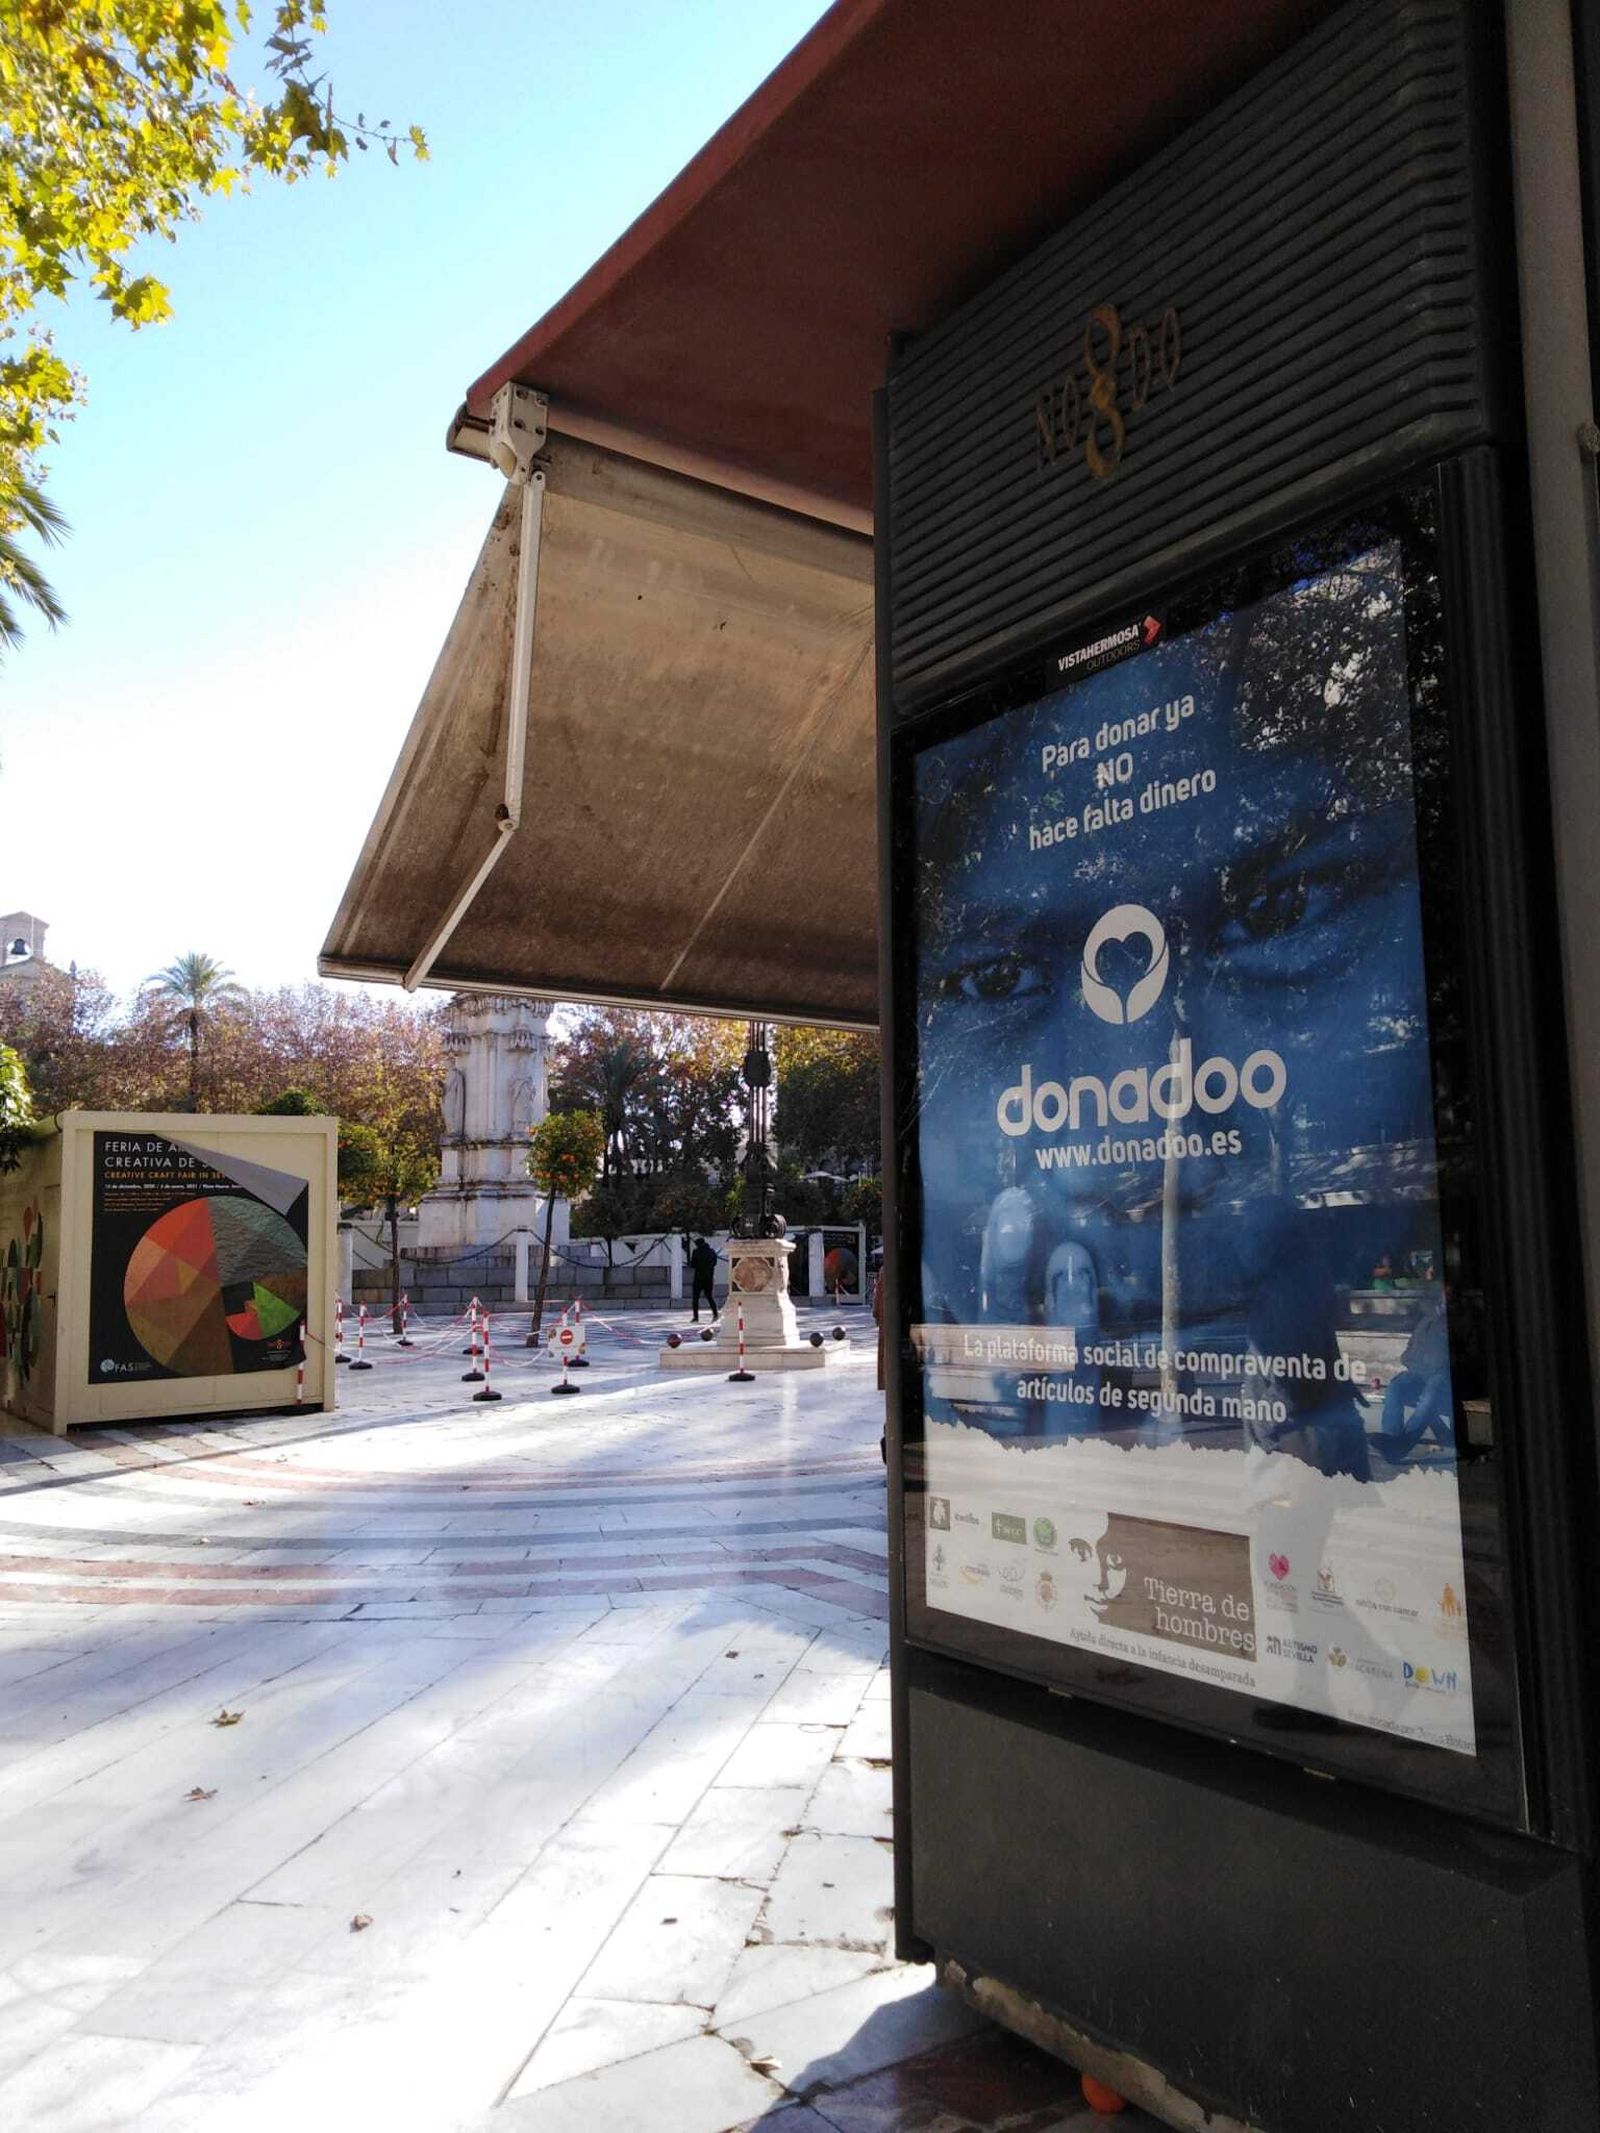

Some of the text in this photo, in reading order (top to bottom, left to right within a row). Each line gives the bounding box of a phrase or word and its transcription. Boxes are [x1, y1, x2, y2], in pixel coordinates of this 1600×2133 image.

[1058, 624, 1139, 672] VISTAHERMOSA
[1086, 639, 1140, 671] OUTDOORS
[1042, 694, 1195, 773] Para donar ya
[1096, 752, 1133, 789] NO
[1029, 768, 1217, 851] hace falta dinero
[996, 1037, 1287, 1137] donadoo
[104, 1157, 172, 1168] CREATIVA
[179, 1157, 195, 1168] DE
[105, 1141, 141, 1153] FERIA
[147, 1142, 161, 1153] DE
[1035, 1129, 1242, 1170] www.donadoo.es
[104, 1171, 144, 1179] CREATIVE
[148, 1171, 174, 1179] CRAFT
[178, 1171, 196, 1179] FAIR
[199, 1171, 209, 1179] IN
[963, 1335, 1367, 1382] La plataforma social de compraventa de
[1017, 1377, 1287, 1423] artículos de segunda mano
[1144, 1576, 1216, 1615] Tierra
[1221, 1595, 1249, 1622] de
[1155, 1606, 1256, 1651] hombres
[1188, 1657, 1256, 1688] desamparada
